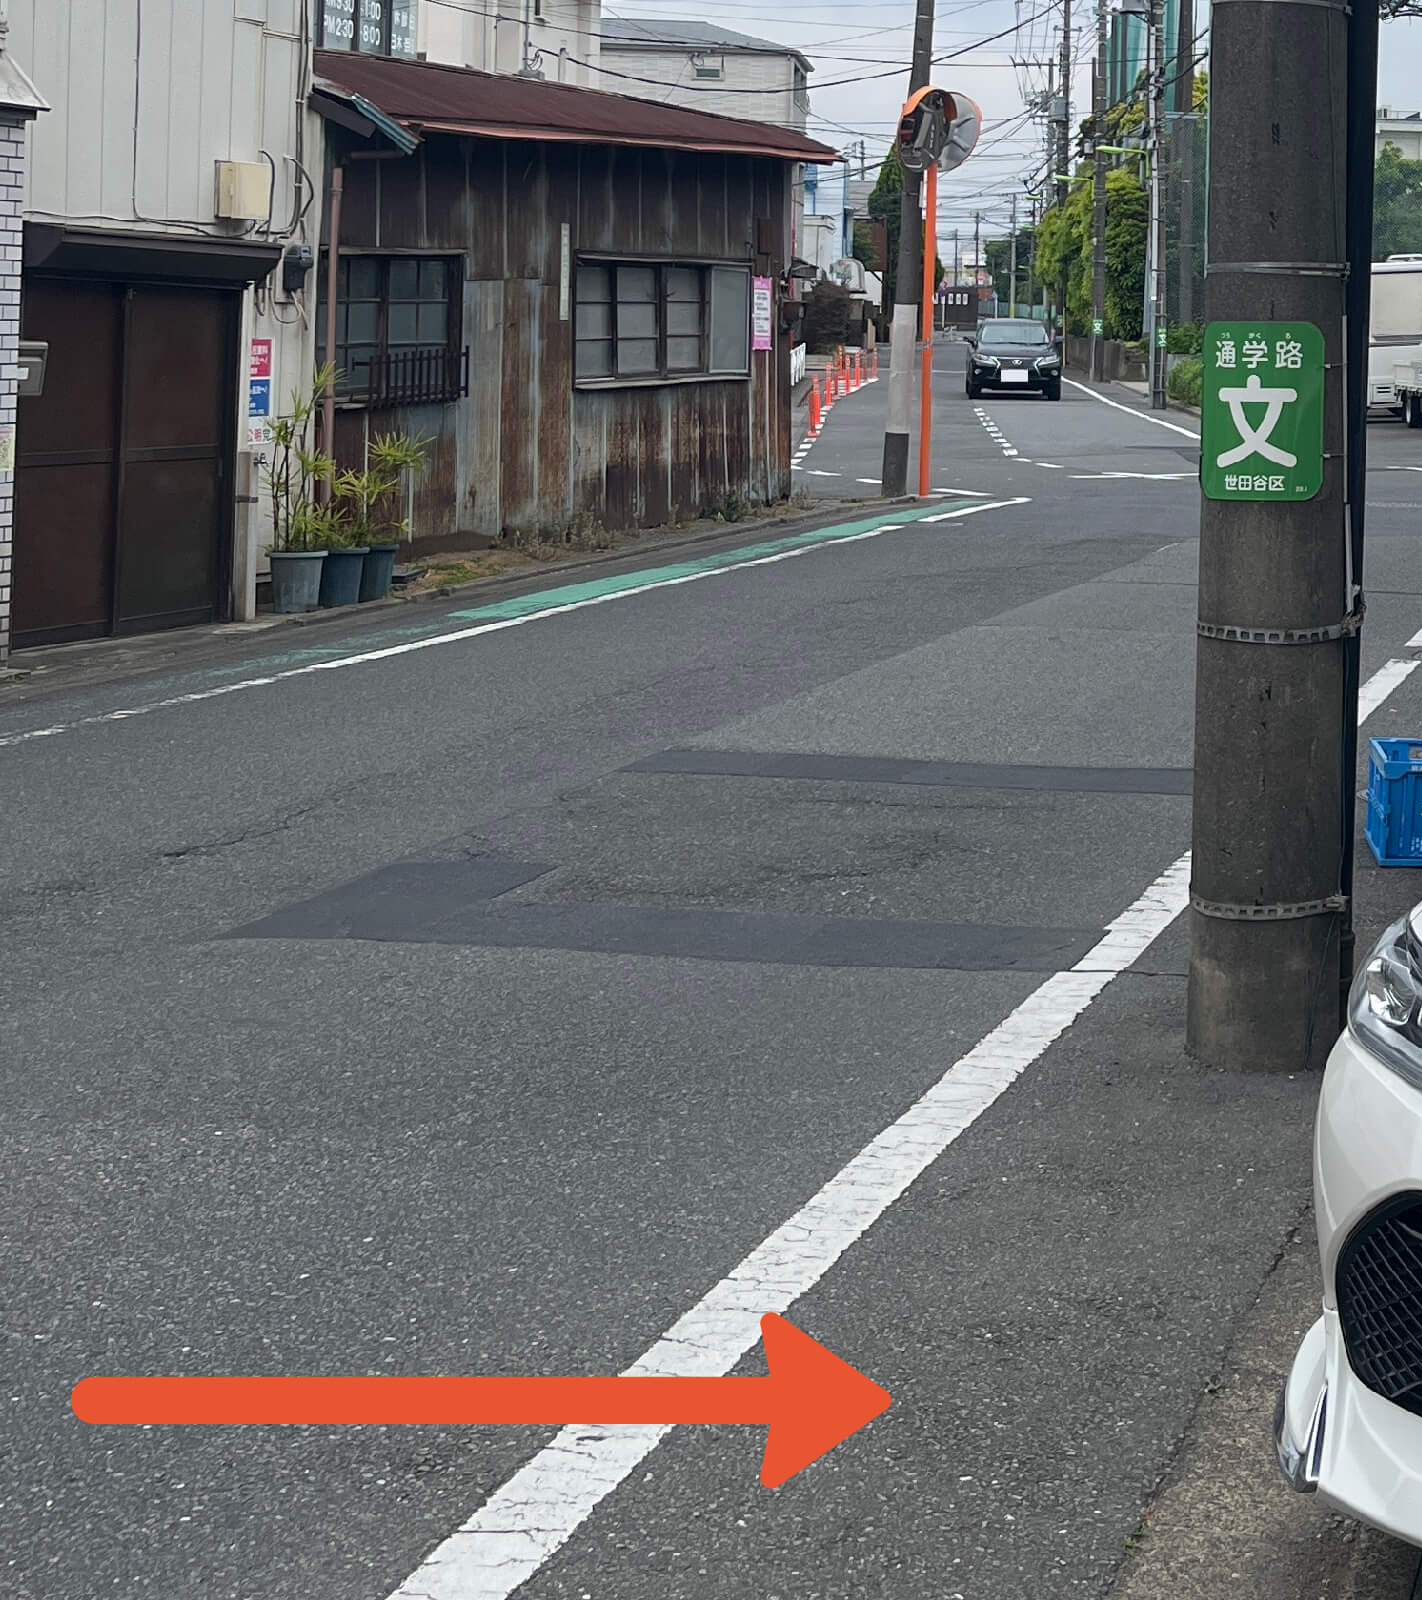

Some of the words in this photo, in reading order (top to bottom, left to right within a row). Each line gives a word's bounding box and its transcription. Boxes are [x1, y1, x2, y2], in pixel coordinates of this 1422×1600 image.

[1216, 340, 1303, 368] 通学路
[1216, 374, 1298, 468] 文
[1224, 474, 1285, 491] 世田谷区
